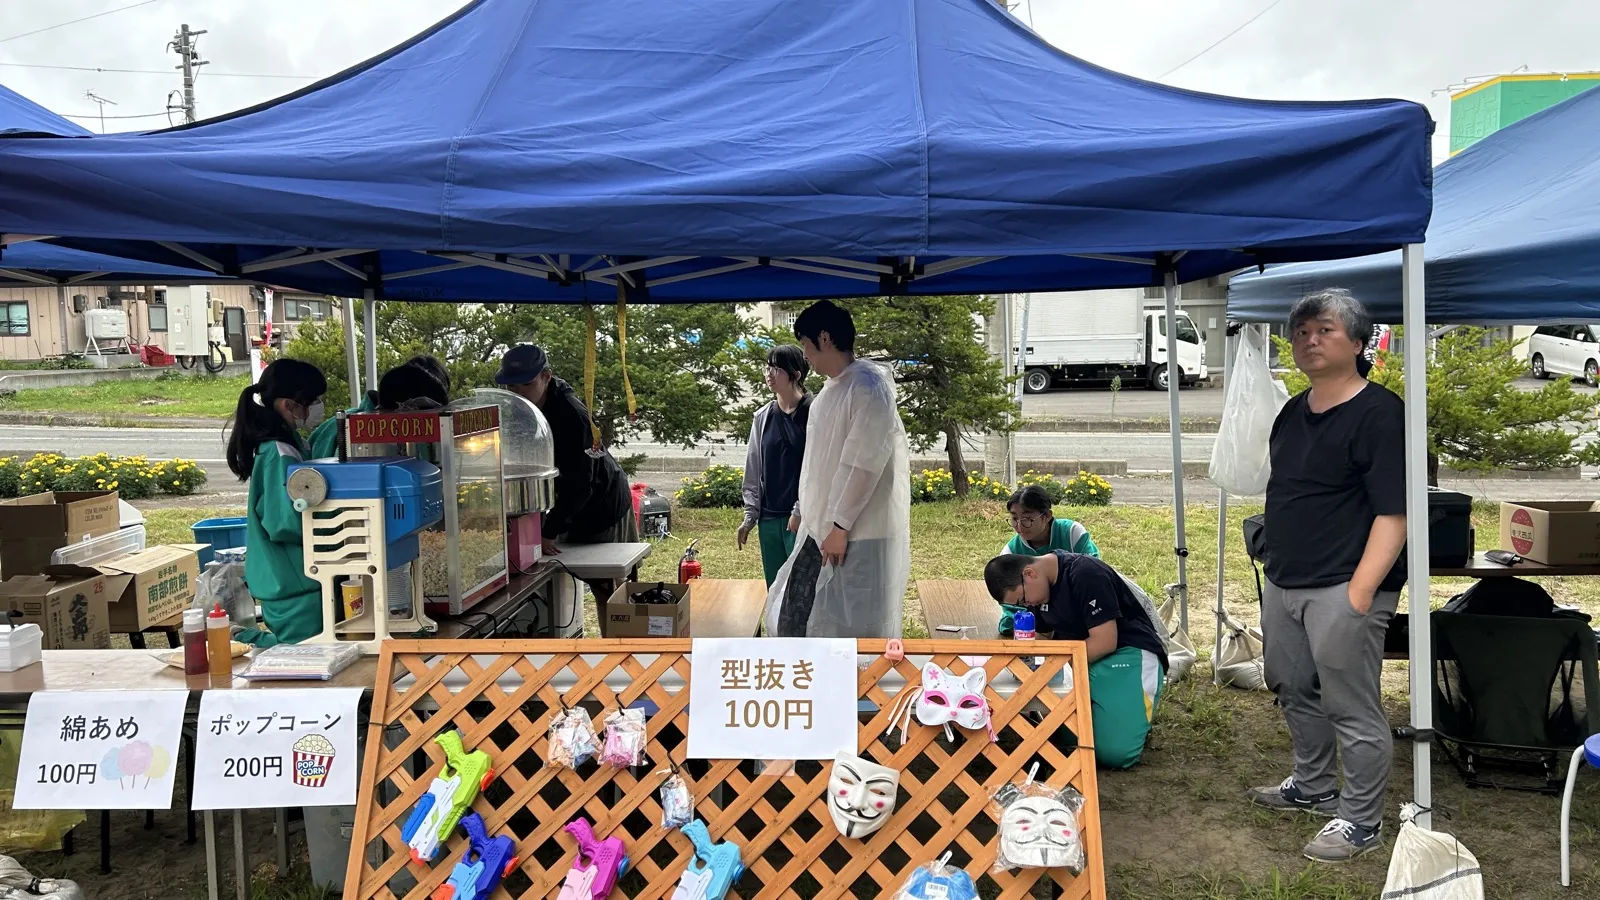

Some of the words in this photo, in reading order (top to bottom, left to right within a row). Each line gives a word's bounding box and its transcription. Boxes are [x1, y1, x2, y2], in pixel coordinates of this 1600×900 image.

[356, 418, 434, 437] POPCORN
[459, 409, 493, 434] POPCORN
[93, 582, 104, 594] 25
[147, 571, 188, 605] 南部煎餅
[720, 658, 814, 690] 型抜き
[210, 711, 342, 736] ポップコーン
[725, 699, 813, 730] 100円
[60, 714, 139, 742] 綿あめ
[36, 762, 97, 785] 100円
[224, 756, 283, 778] 200円
[297, 761, 314, 770] POP
[302, 766, 325, 776] CORN
